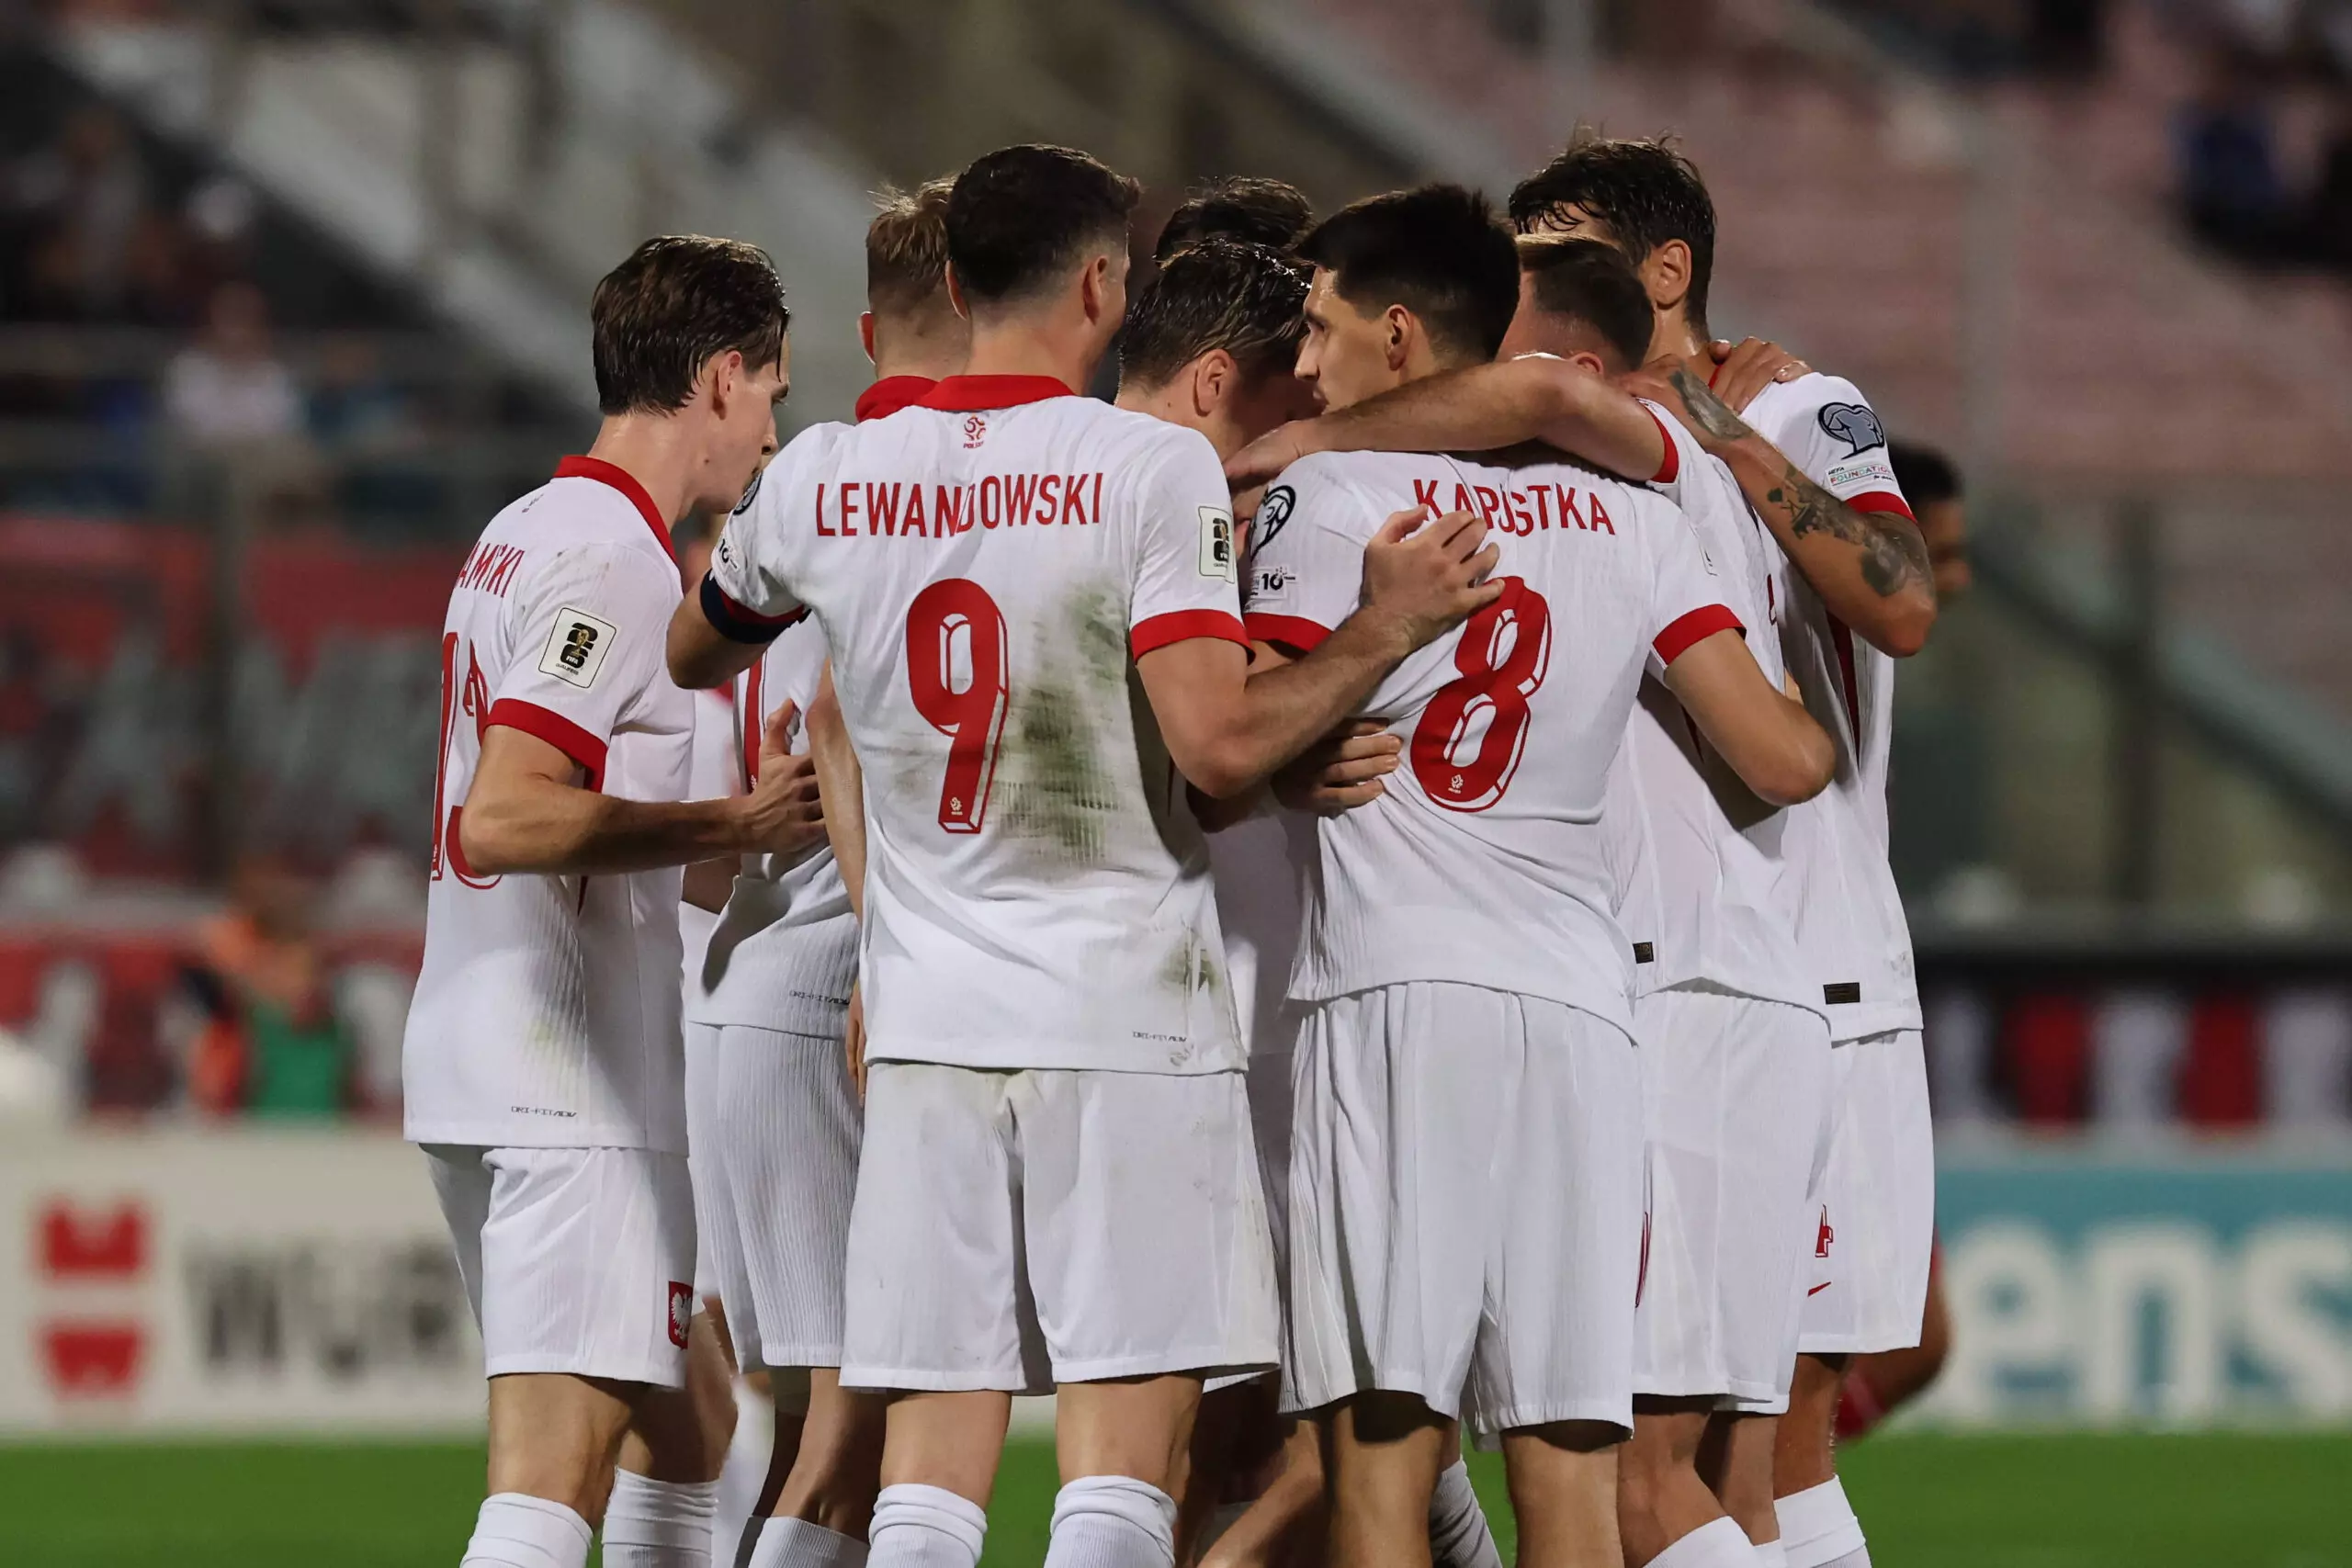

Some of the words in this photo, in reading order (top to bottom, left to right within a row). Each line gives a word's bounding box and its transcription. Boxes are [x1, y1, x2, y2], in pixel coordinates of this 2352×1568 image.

[815, 472, 1103, 540] LEWANDOWSKI
[1830, 466, 1889, 484] FOUNDATIO
[565, 655, 579, 665] FIFA
[1410, 575, 1552, 813] 8
[906, 578, 1010, 834] 9
